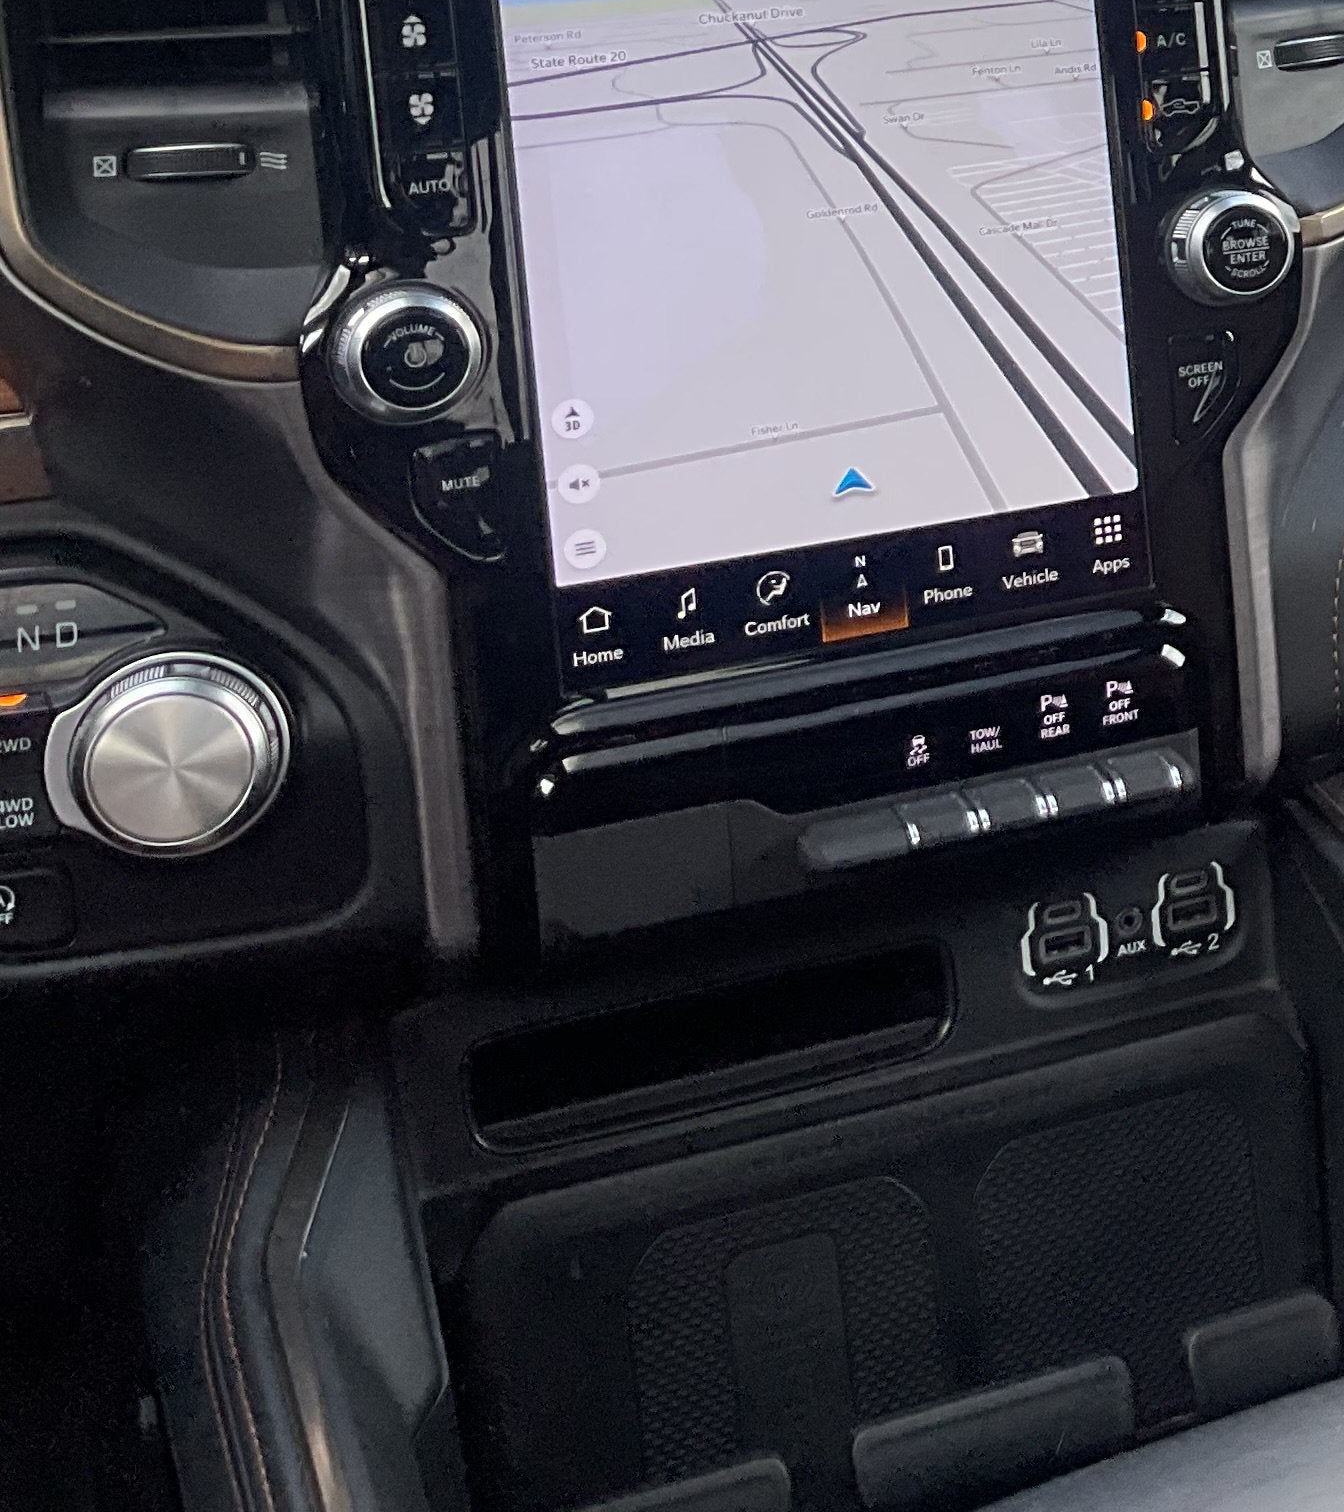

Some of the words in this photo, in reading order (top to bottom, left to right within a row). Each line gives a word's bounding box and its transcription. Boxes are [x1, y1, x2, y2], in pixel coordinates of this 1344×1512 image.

[770, 6, 804, 19] Drive
[514, 32, 564, 44] Peterson
[567, 29, 582, 39] Rd
[1156, 31, 1187, 48] A/C
[530, 56, 566, 69] State
[568, 54, 607, 65] Route
[610, 51, 627, 62] 20
[408, 178, 450, 196] AUTO
[864, 202, 878, 213] Rd
[1231, 218, 1257, 229] TUNE
[1222, 236, 1269, 251] BROWSE
[1230, 251, 1266, 265] ENTER
[1230, 266, 1266, 278] SCROLL
[390, 324, 436, 340] VOLUME
[1178, 360, 1223, 377] SCREEN
[1188, 376, 1210, 388] OFF
[565, 419, 581, 432] 3D
[750, 423, 782, 437] Fisher
[784, 420, 799, 431] Ln
[441, 475, 481, 491] MUTE
[855, 556, 866, 567] N
[1092, 554, 1131, 576] Apps
[1002, 568, 1059, 590] Vehicle
[923, 583, 973, 606] Phone
[848, 599, 881, 618] Nav
[744, 611, 811, 637] Comfort
[17, 625, 40, 652] N
[55, 621, 78, 648] D
[663, 628, 715, 652] Media
[572, 644, 624, 668] Home
[1109, 697, 1131, 711] OFF
[1044, 711, 1065, 725] OFF
[1102, 709, 1139, 726] FRONT
[970, 725, 1002, 741] TOW/
[1040, 723, 1070, 739] REAR
[0, 737, 31, 753] WD
[971, 738, 1002, 754] HAUL
[907, 752, 930, 768] OFF
[1117, 939, 1146, 957] AUX
[1208, 933, 1219, 951] 2
[1086, 964, 1095, 982] 1
